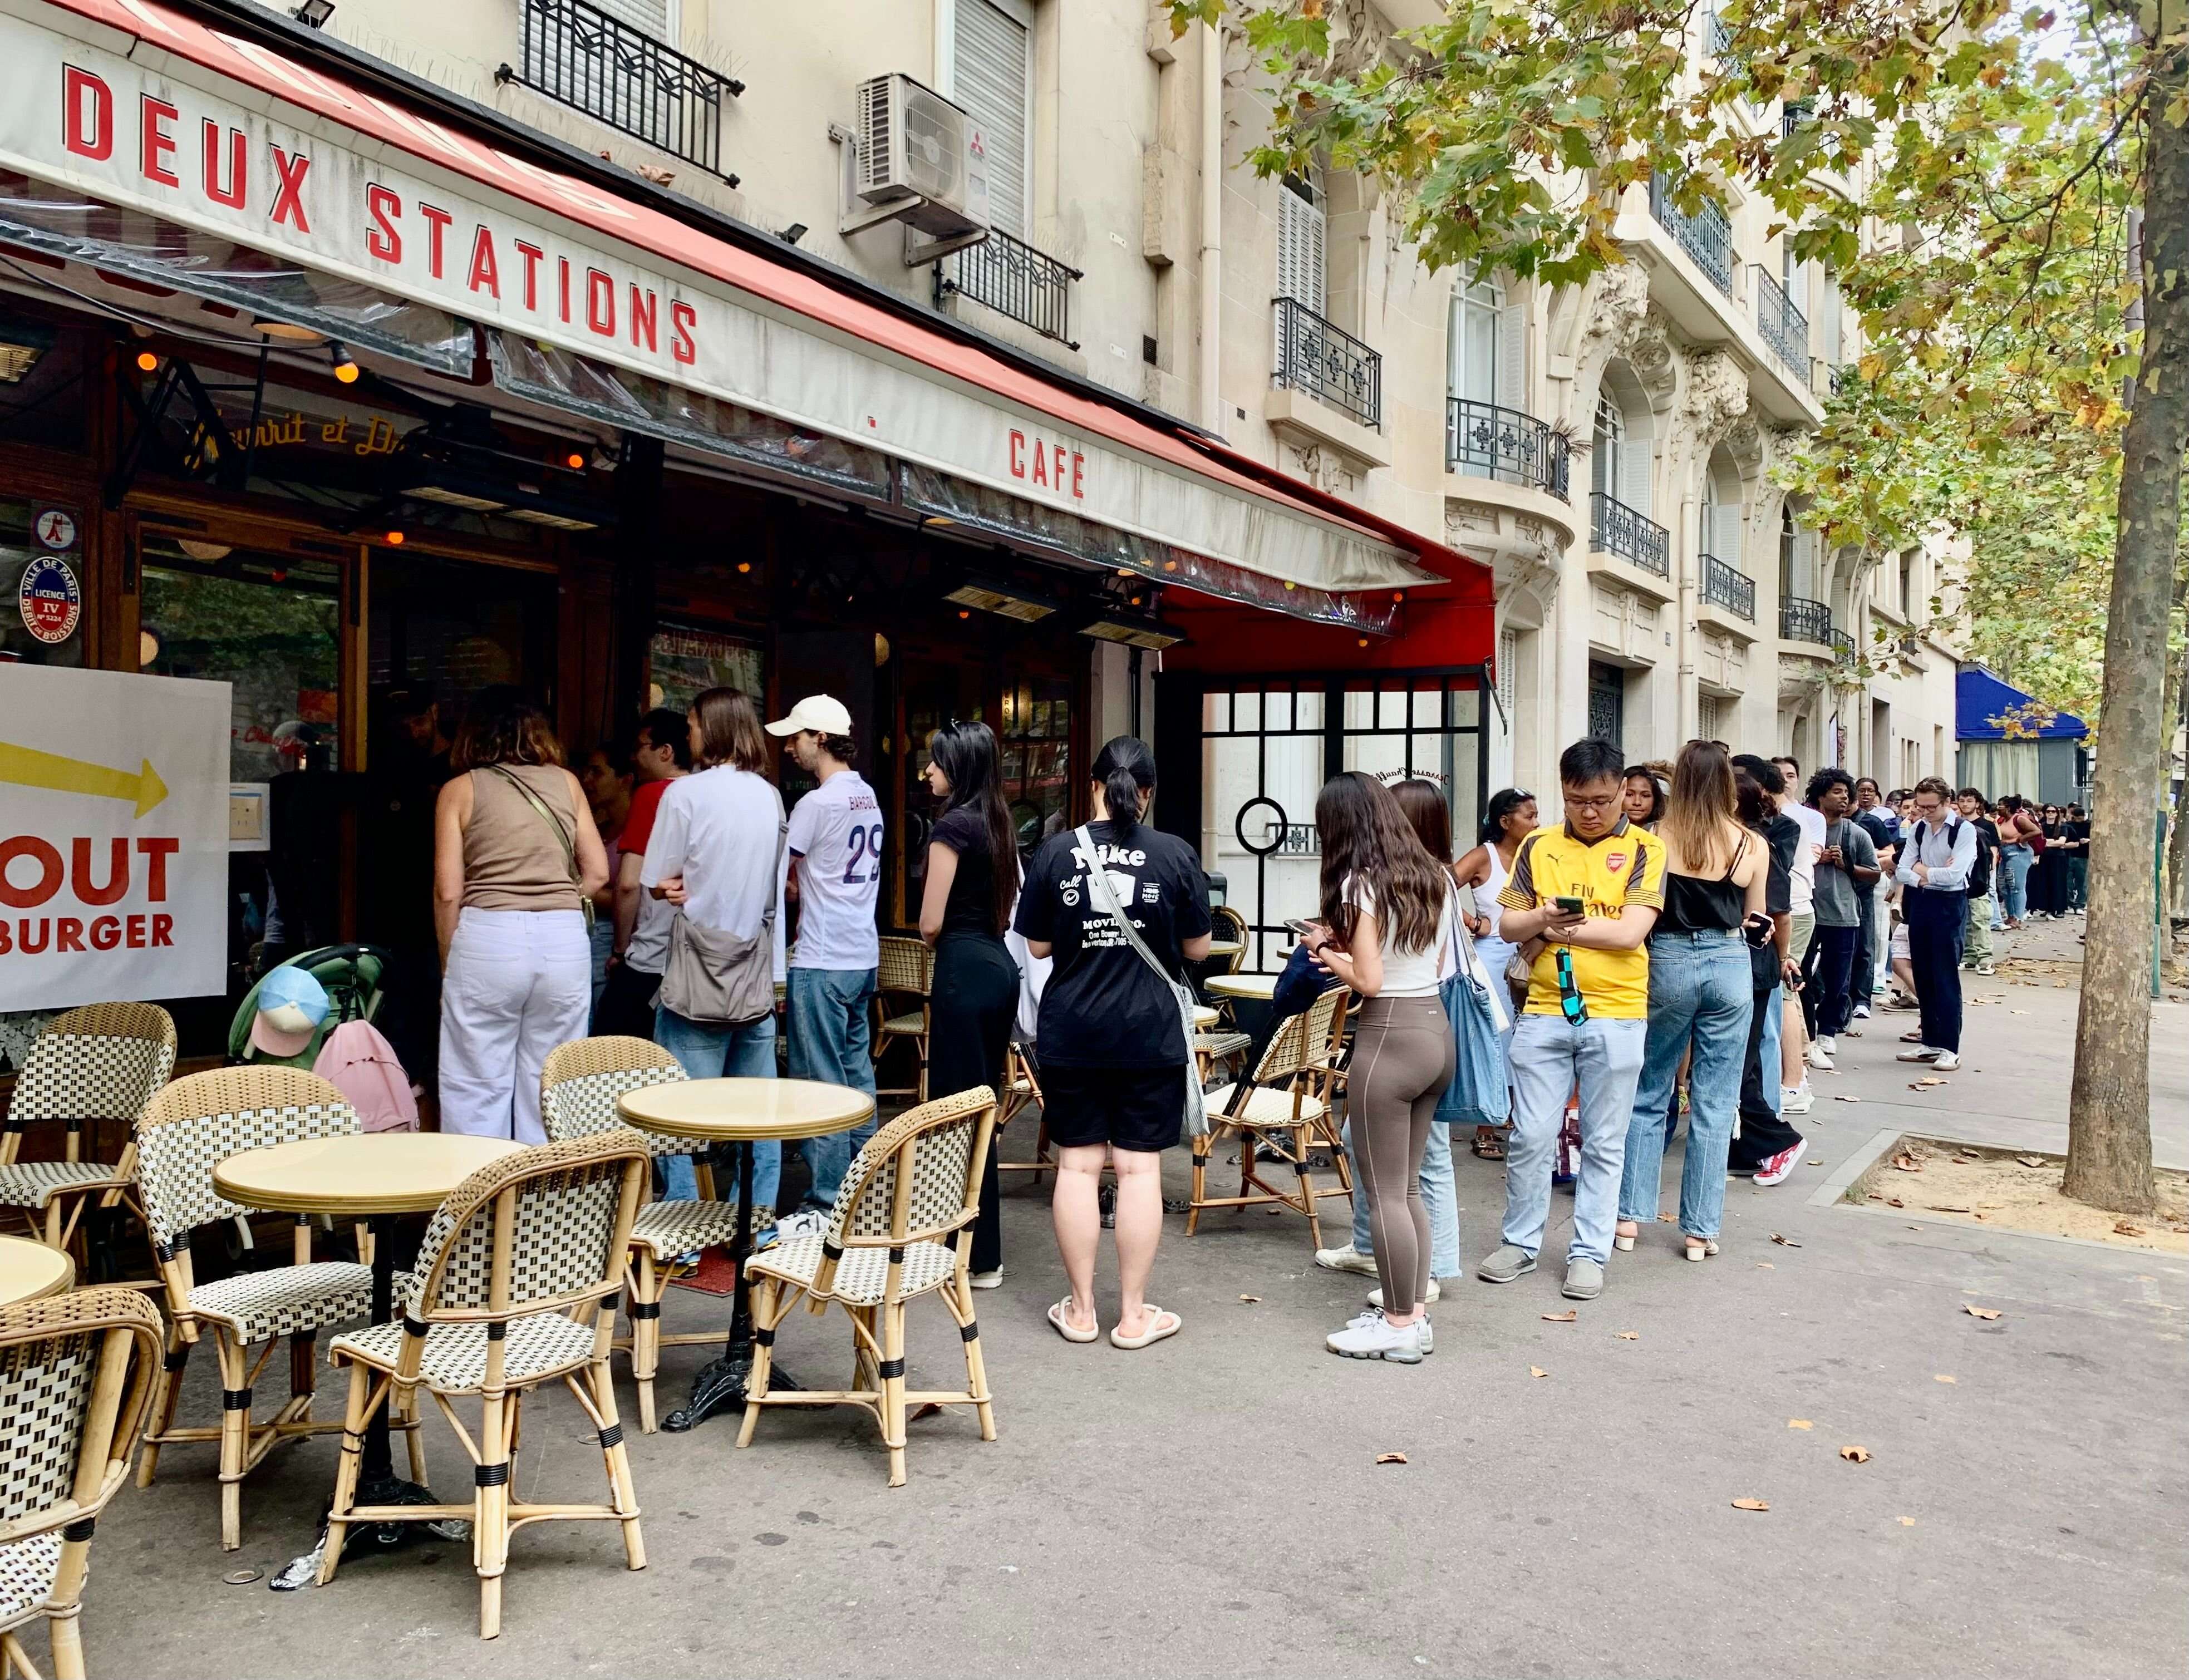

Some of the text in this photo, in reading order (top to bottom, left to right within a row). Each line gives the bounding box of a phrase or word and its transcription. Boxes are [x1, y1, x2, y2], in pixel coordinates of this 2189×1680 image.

[62, 61, 697, 366] DEUX STATIONS
[321, 415, 350, 444] et
[1009, 428, 1085, 499] CAFE
[23, 559, 77, 597] VILLE DE PARIS
[35, 589, 65, 600] LICENCE
[43, 602, 60, 613] IV
[22, 598, 77, 641] DEBIT DE BOISSONS
[843, 824, 883, 884] 29
[0, 836, 179, 908] OUT
[1060, 875, 1082, 890] Call
[1571, 883, 1594, 900] Fly
[1083, 918, 1119, 930] MOVI
[1089, 931, 1099, 939] One
